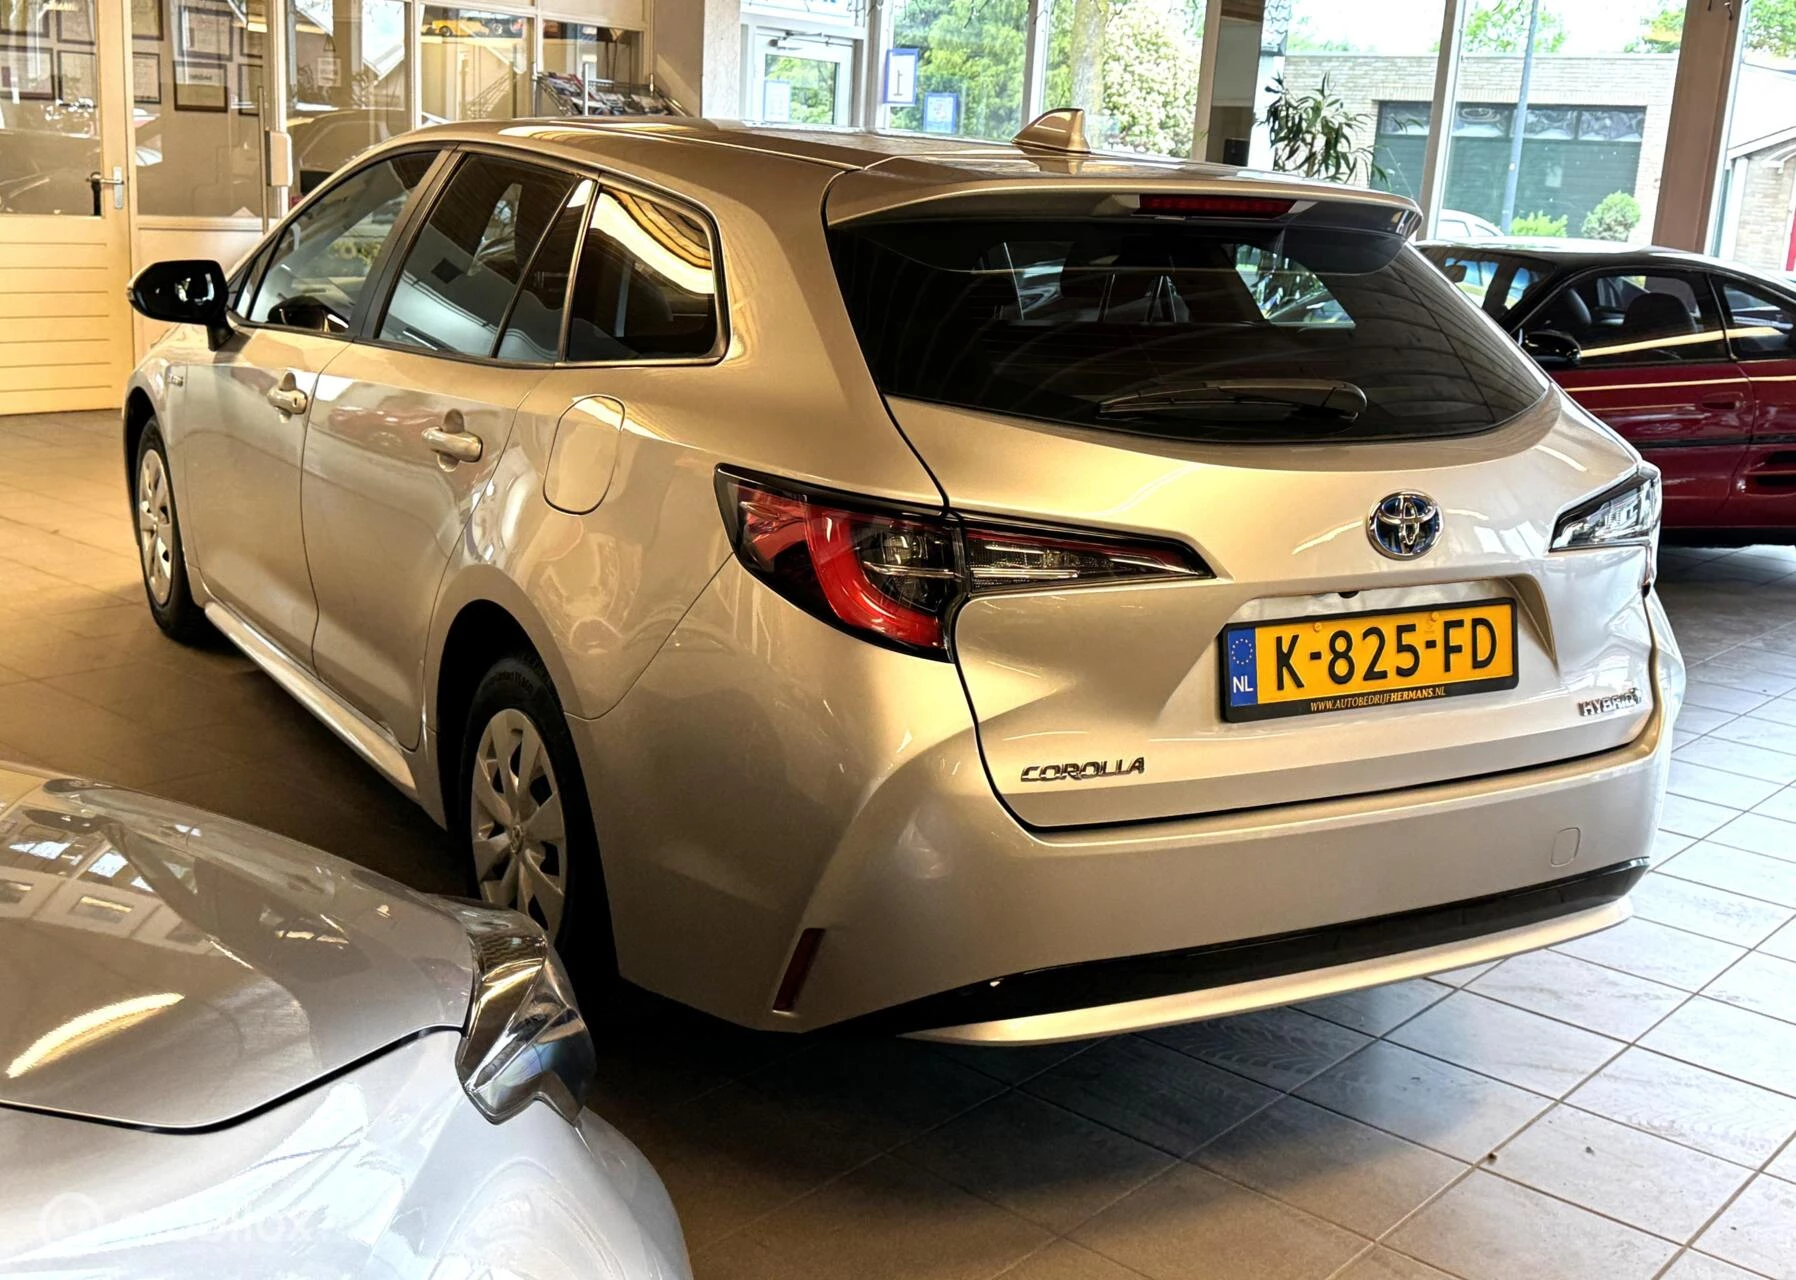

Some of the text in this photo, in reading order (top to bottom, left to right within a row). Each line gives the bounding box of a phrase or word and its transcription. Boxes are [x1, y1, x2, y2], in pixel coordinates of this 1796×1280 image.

[1276, 617, 1497, 691] K-825-FD
[1233, 675, 1254, 694] NL
[1310, 686, 1446, 712] WWW.AUTOBEDRIJFHERMANS.NL
[1577, 687, 1641, 716] HYBRID
[1021, 757, 1145, 782] COROLLA
